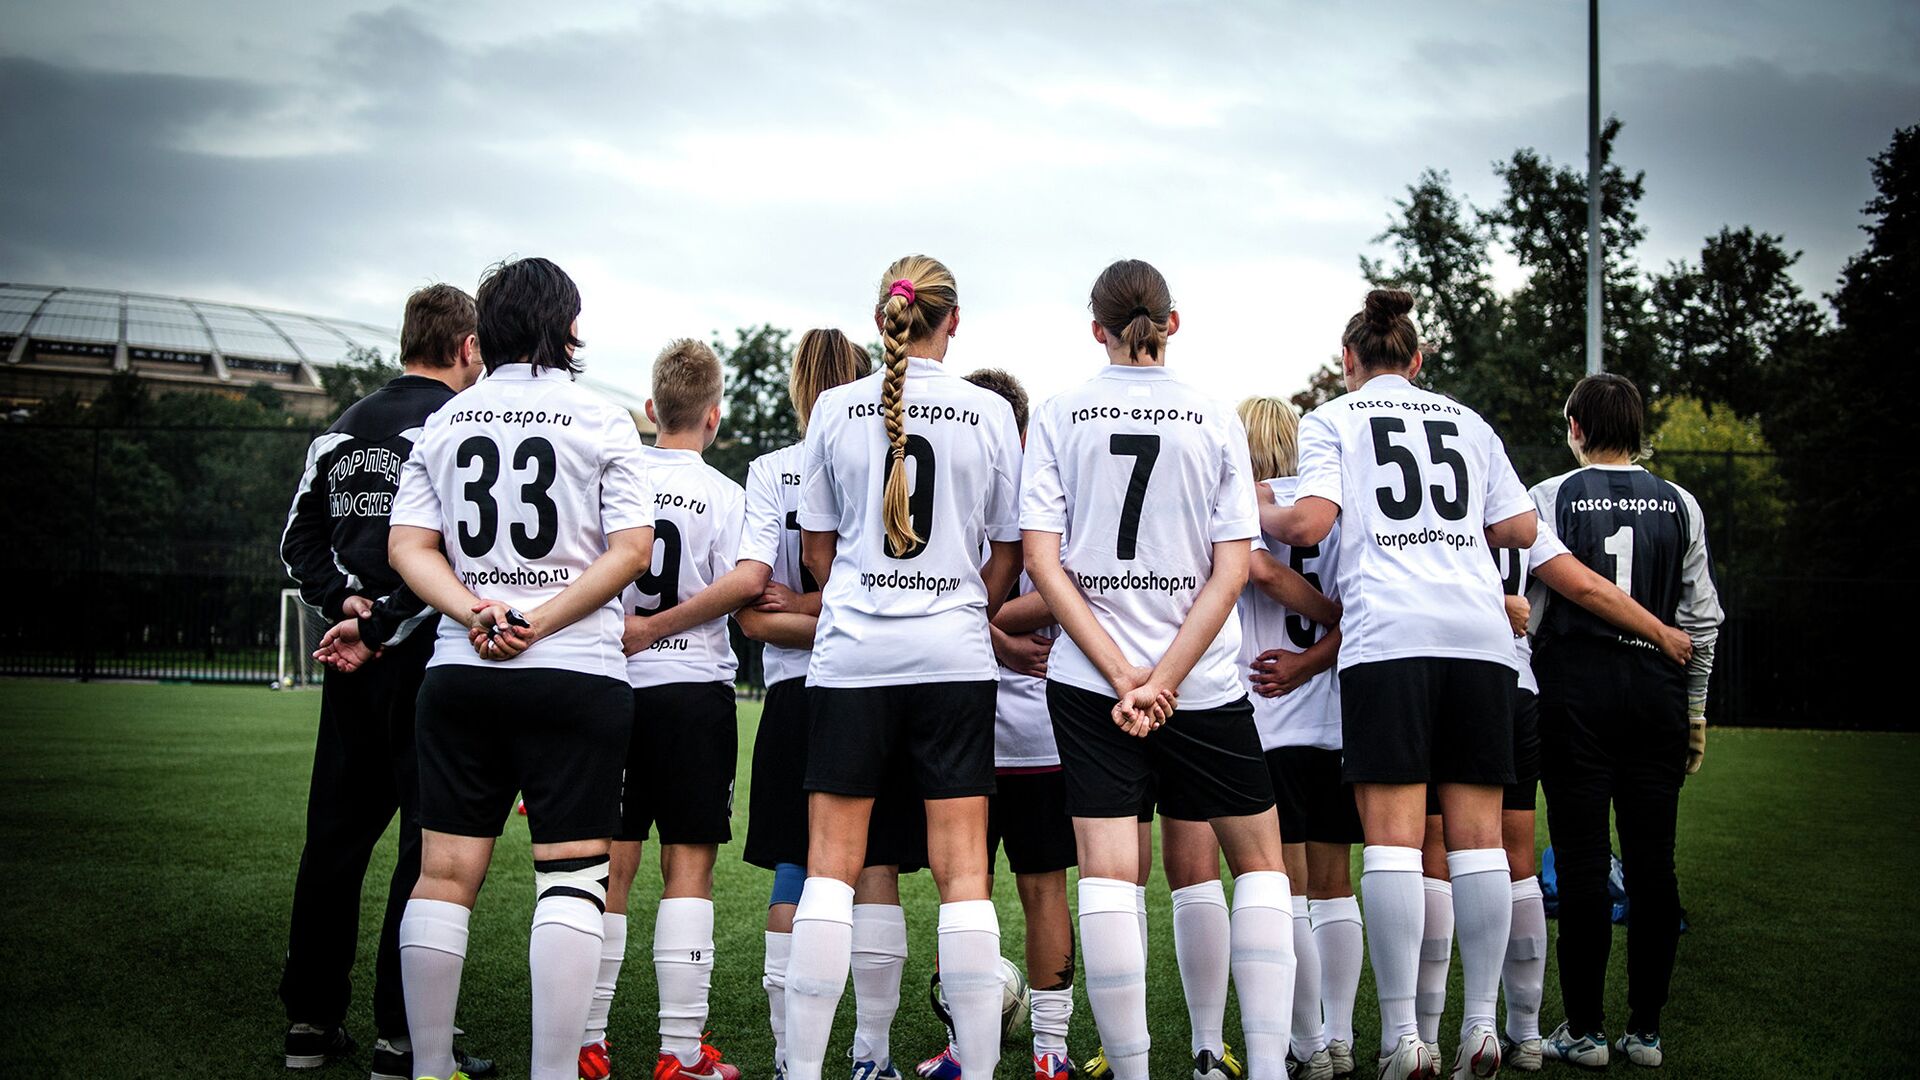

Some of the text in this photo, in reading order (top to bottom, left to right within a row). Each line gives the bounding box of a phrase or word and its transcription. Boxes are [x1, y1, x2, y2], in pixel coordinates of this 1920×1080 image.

[450, 410, 573, 427] rasco-expo.ru
[848, 403, 979, 426] rasc-expo.ru
[1072, 406, 1203, 425] rasco-expo.ru
[1349, 400, 1461, 416] rasco-expo.ru
[1369, 417, 1469, 521] 55
[456, 436, 558, 559] 33
[1110, 433, 1160, 560] 7
[1571, 498, 1676, 516] rasco-expo.ru
[1376, 527, 1477, 551] torpedosop.r
[1604, 526, 1634, 594] 1
[1078, 571, 1196, 596] torpedoshop.ru
[648, 638, 688, 652] op.ru
[690, 950, 701, 961] 19
